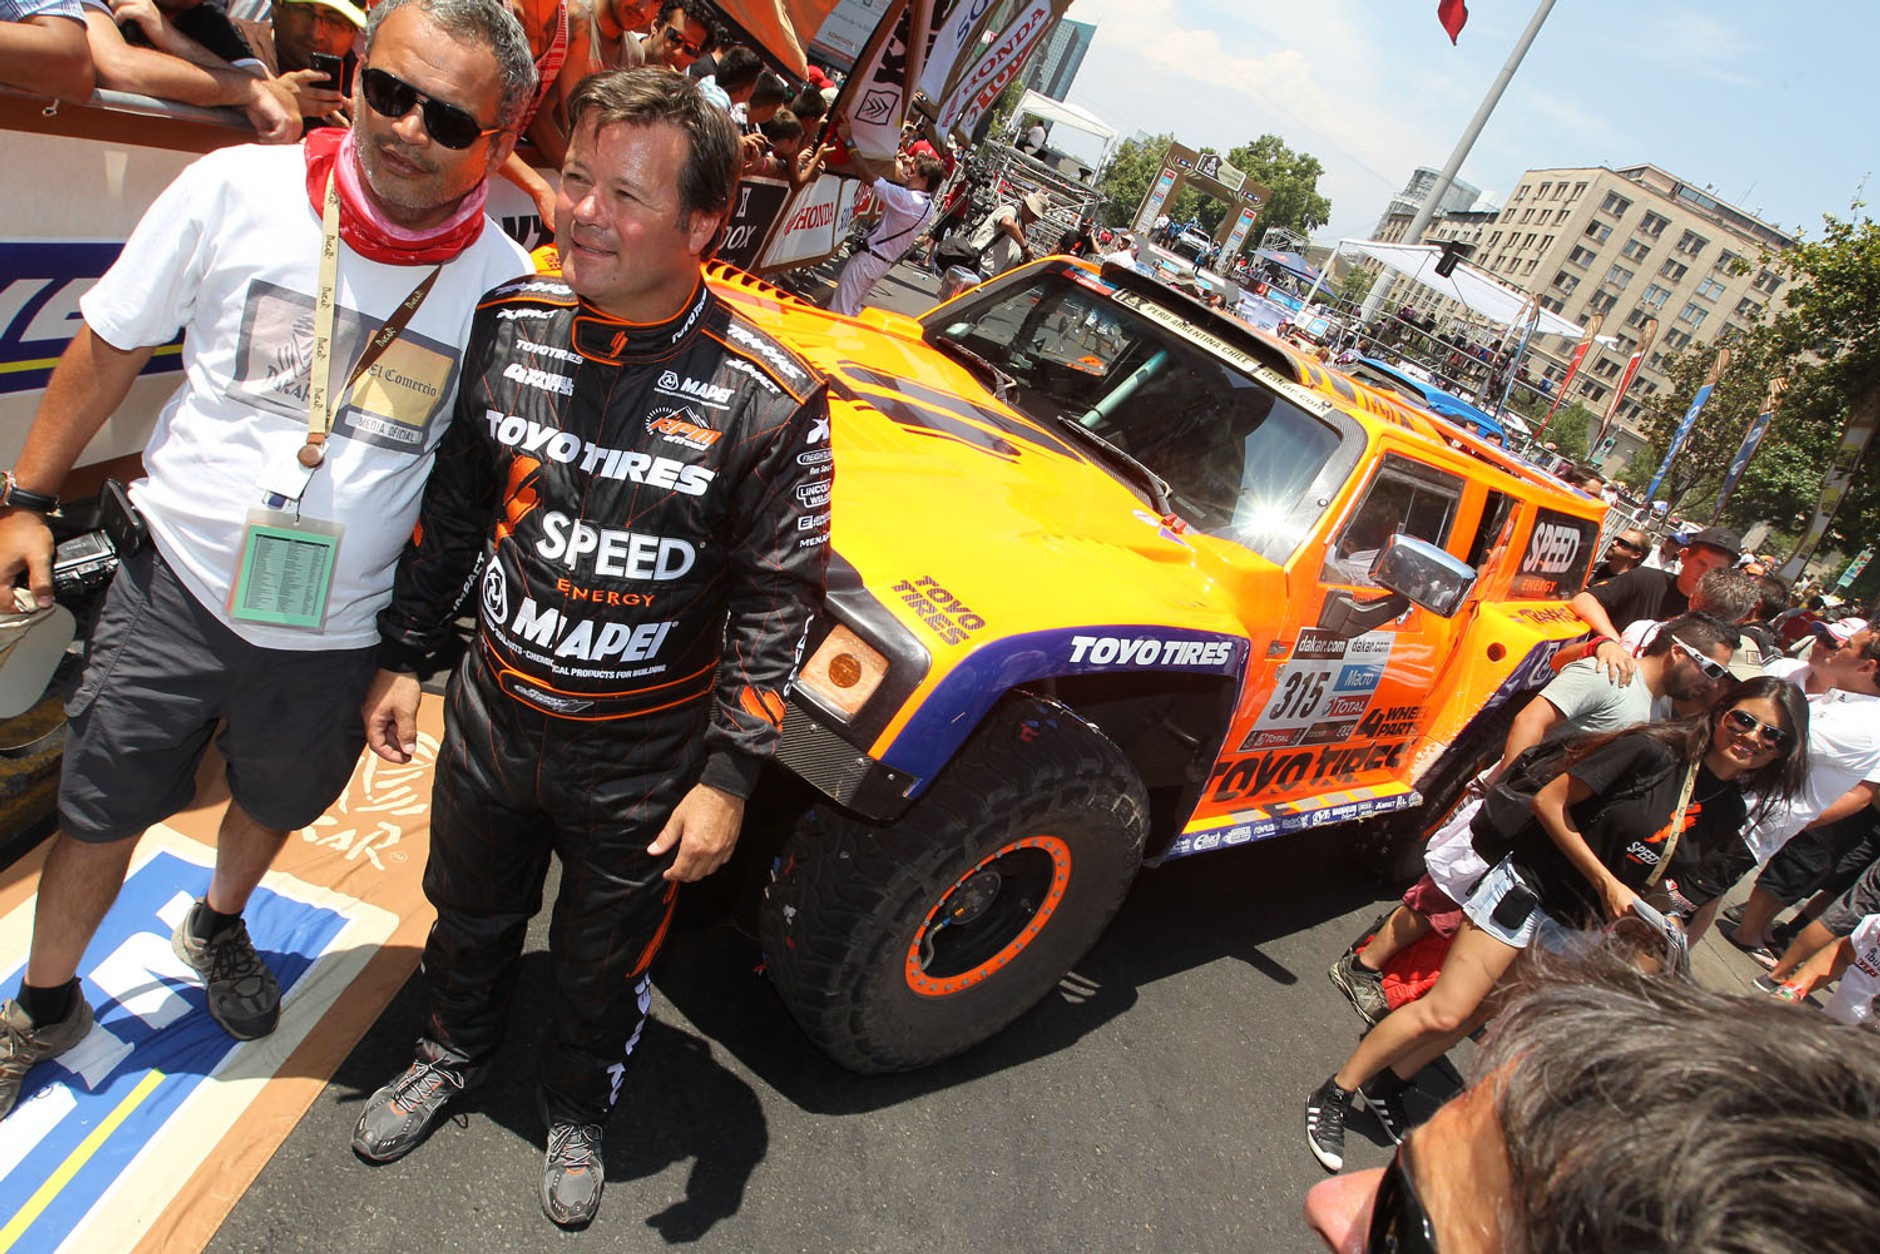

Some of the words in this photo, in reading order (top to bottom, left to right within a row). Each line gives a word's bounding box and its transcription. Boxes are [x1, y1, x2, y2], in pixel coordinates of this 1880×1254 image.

[962, 8, 1046, 95] HONDA
[794, 202, 834, 230] HONDA
[1146, 305, 1171, 325] PERU
[1169, 316, 1221, 350] ARGENTINA
[1221, 344, 1251, 366] CHILE
[368, 362, 383, 378] El
[384, 368, 438, 397] Comercio
[680, 377, 735, 404] MAPEI
[1260, 370, 1329, 413] dakar.com
[485, 409, 582, 464] TOYO
[579, 441, 717, 497] TIRES
[536, 511, 696, 581] SPEED
[1522, 521, 1581, 574] SPEED
[452, 551, 485, 612] IMPACT
[556, 577, 656, 608] ENERGY
[1521, 579, 1558, 593] ENERGY
[891, 580, 970, 646] TIRES
[914, 575, 987, 631] TOYO
[511, 596, 673, 663] MAPEI
[1299, 635, 1346, 653] dakar.com
[1351, 638, 1391, 653] dakar.com
[1069, 635, 1162, 665] TOYO
[1160, 641, 1233, 666] TIRES
[1269, 671, 1332, 720] 315
[1344, 669, 1373, 687] Macro
[1333, 699, 1365, 714] TOTAL
[1355, 708, 1385, 738] 4
[1263, 734, 1290, 744] TOTAL
[1207, 751, 1314, 803] TOYO
[1626, 841, 1661, 865] SPEED
